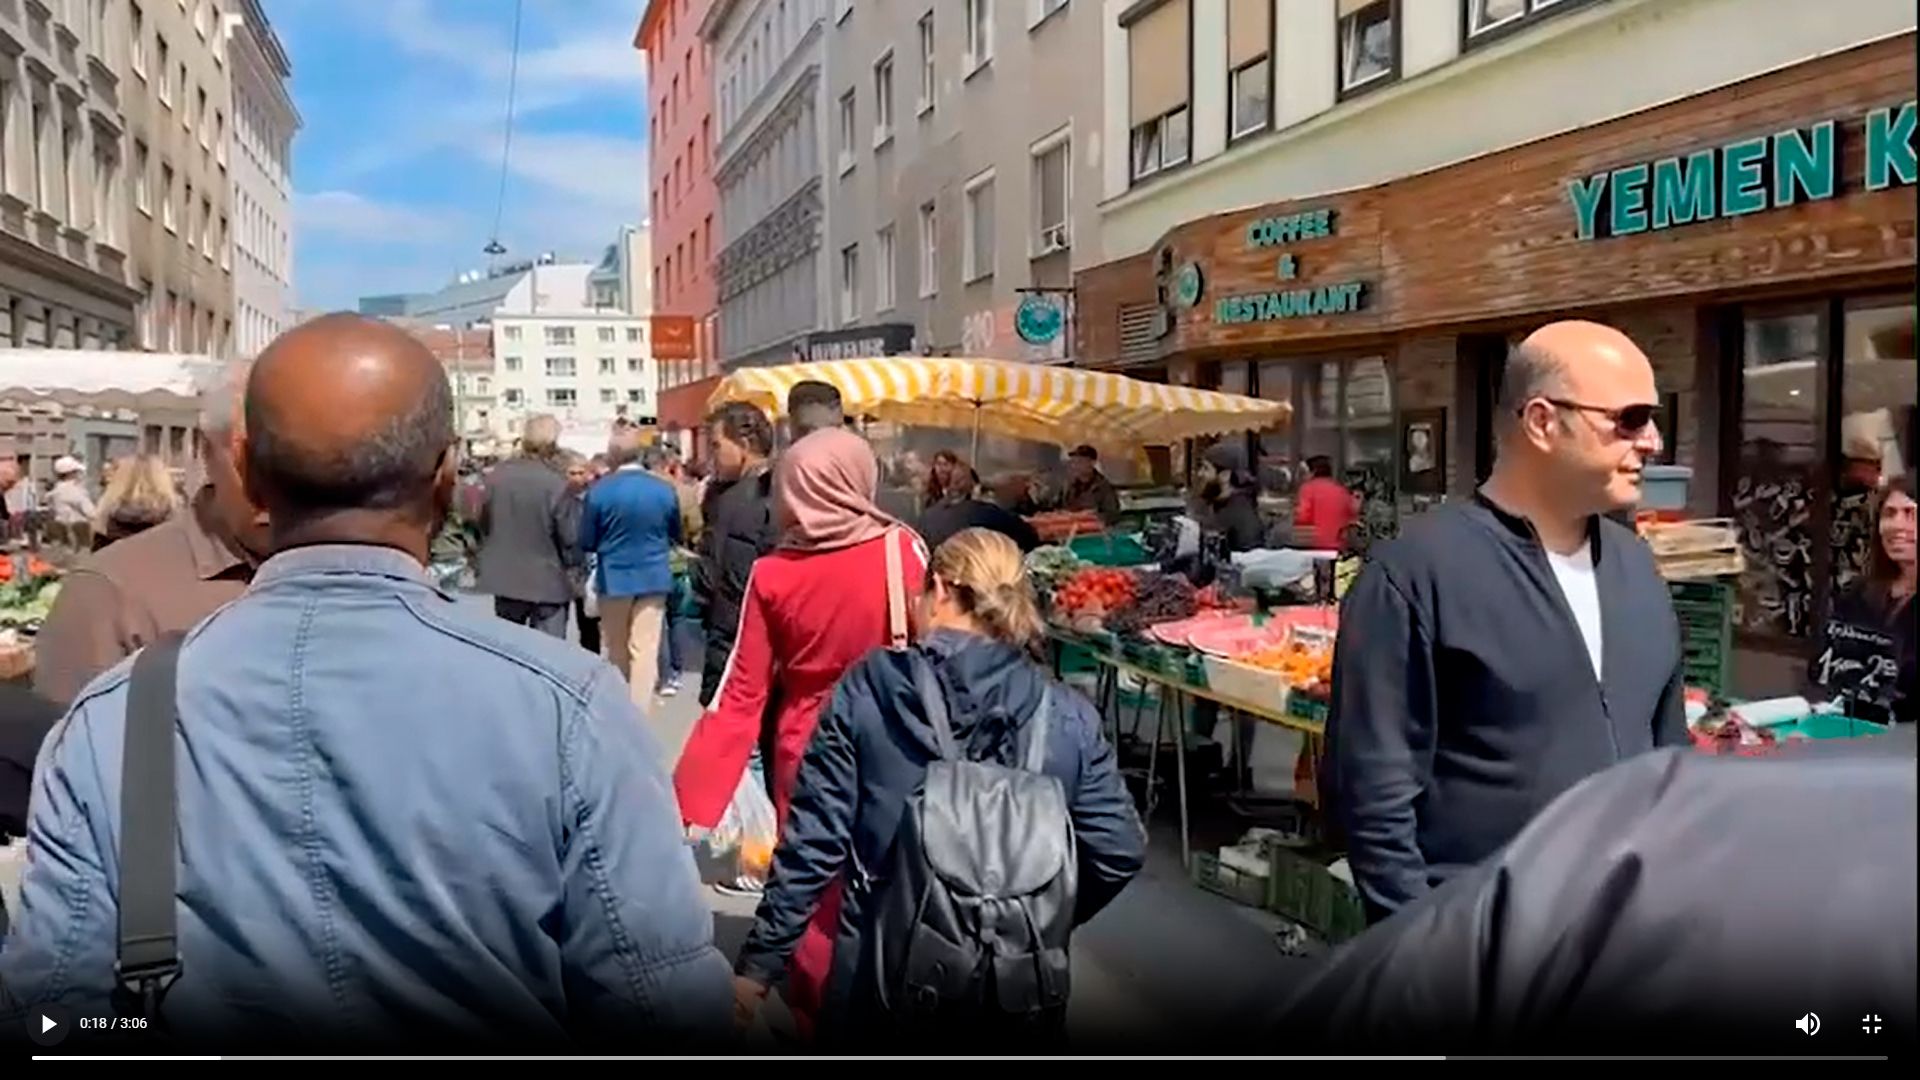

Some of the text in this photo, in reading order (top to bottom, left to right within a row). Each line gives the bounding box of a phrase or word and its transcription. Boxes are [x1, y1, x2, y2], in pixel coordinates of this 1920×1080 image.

[1567, 120, 1834, 240] YEMEN
[1247, 209, 1334, 248] COFFEE
[1278, 253, 1297, 281] &
[1215, 281, 1363, 323] RESTAURANT
